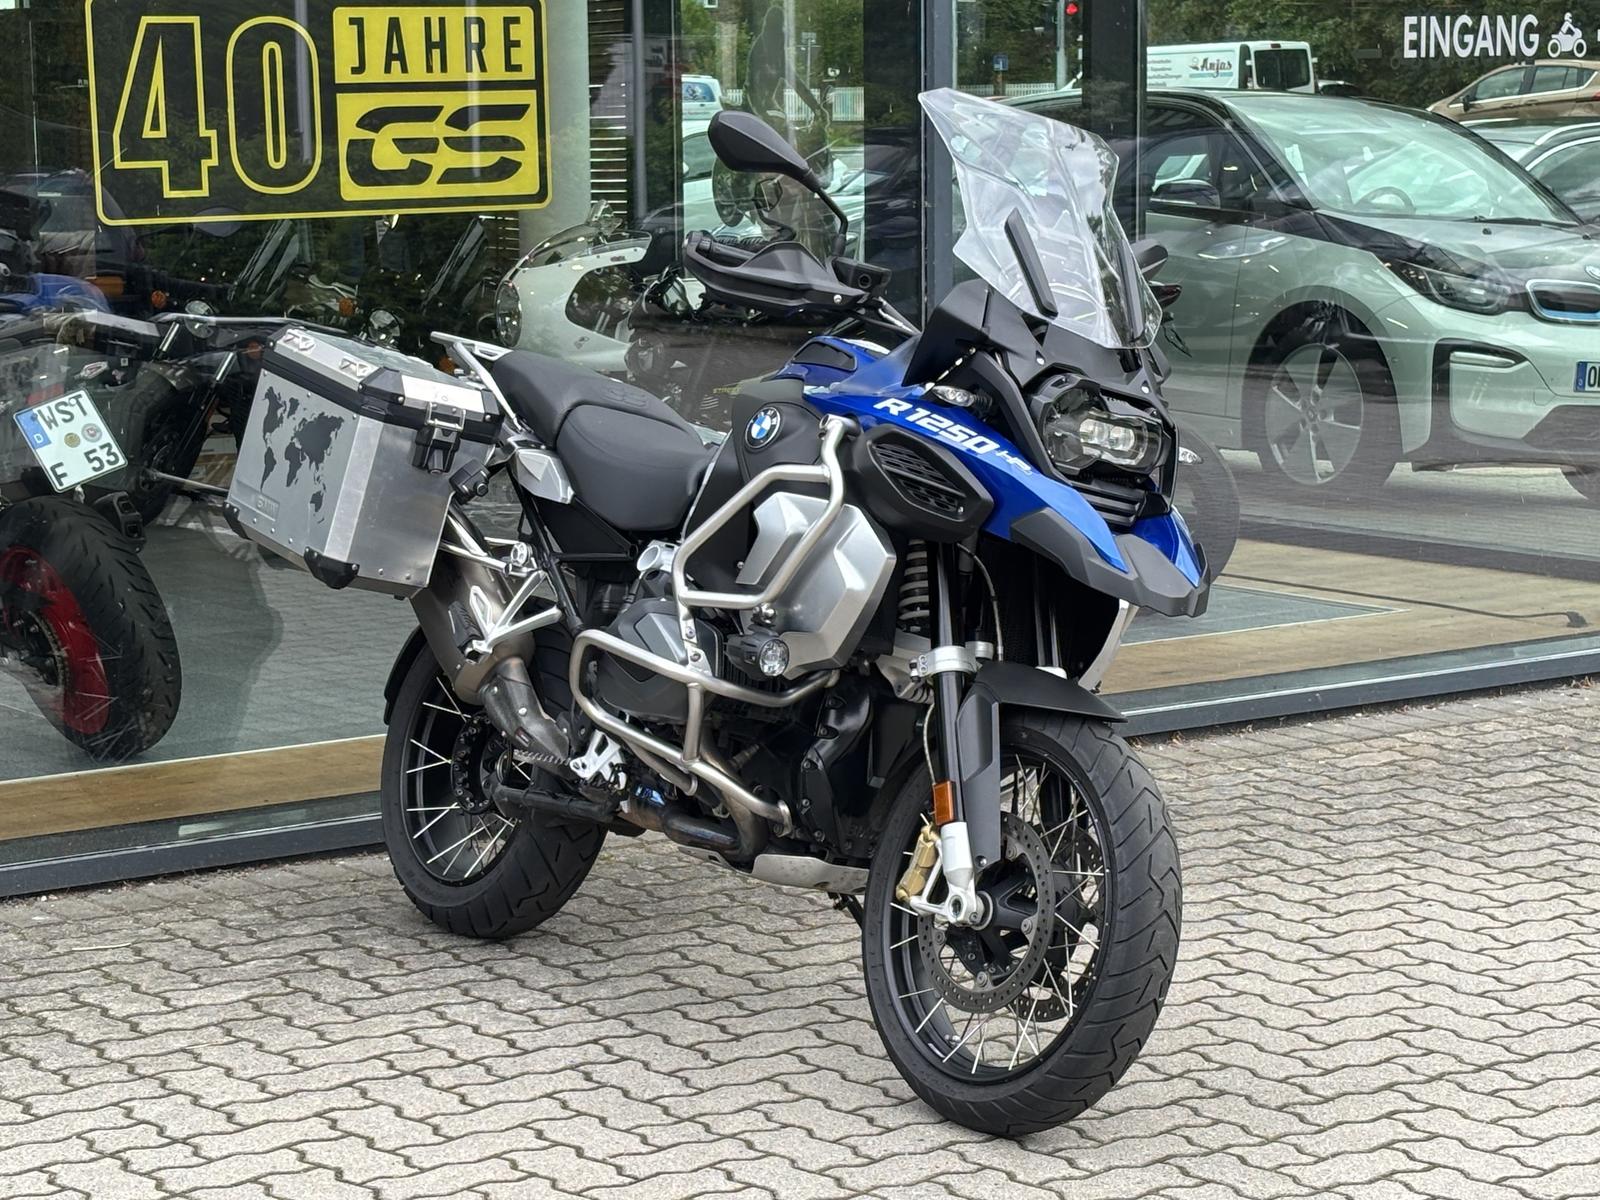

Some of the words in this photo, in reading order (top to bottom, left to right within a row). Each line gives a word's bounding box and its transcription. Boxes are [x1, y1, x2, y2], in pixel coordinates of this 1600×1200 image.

[348, 16, 523, 75] JAHRE
[1403, 14, 1540, 59] EINGANG
[113, 16, 322, 198] 40
[346, 103, 531, 187] GS
[1587, 365, 1600, 388] O
[37, 393, 88, 430] WST
[873, 397, 913, 416] R
[905, 407, 1001, 455] 1250
[33, 433, 44, 443] D
[49, 461, 68, 487] F
[83, 442, 120, 472] 53
